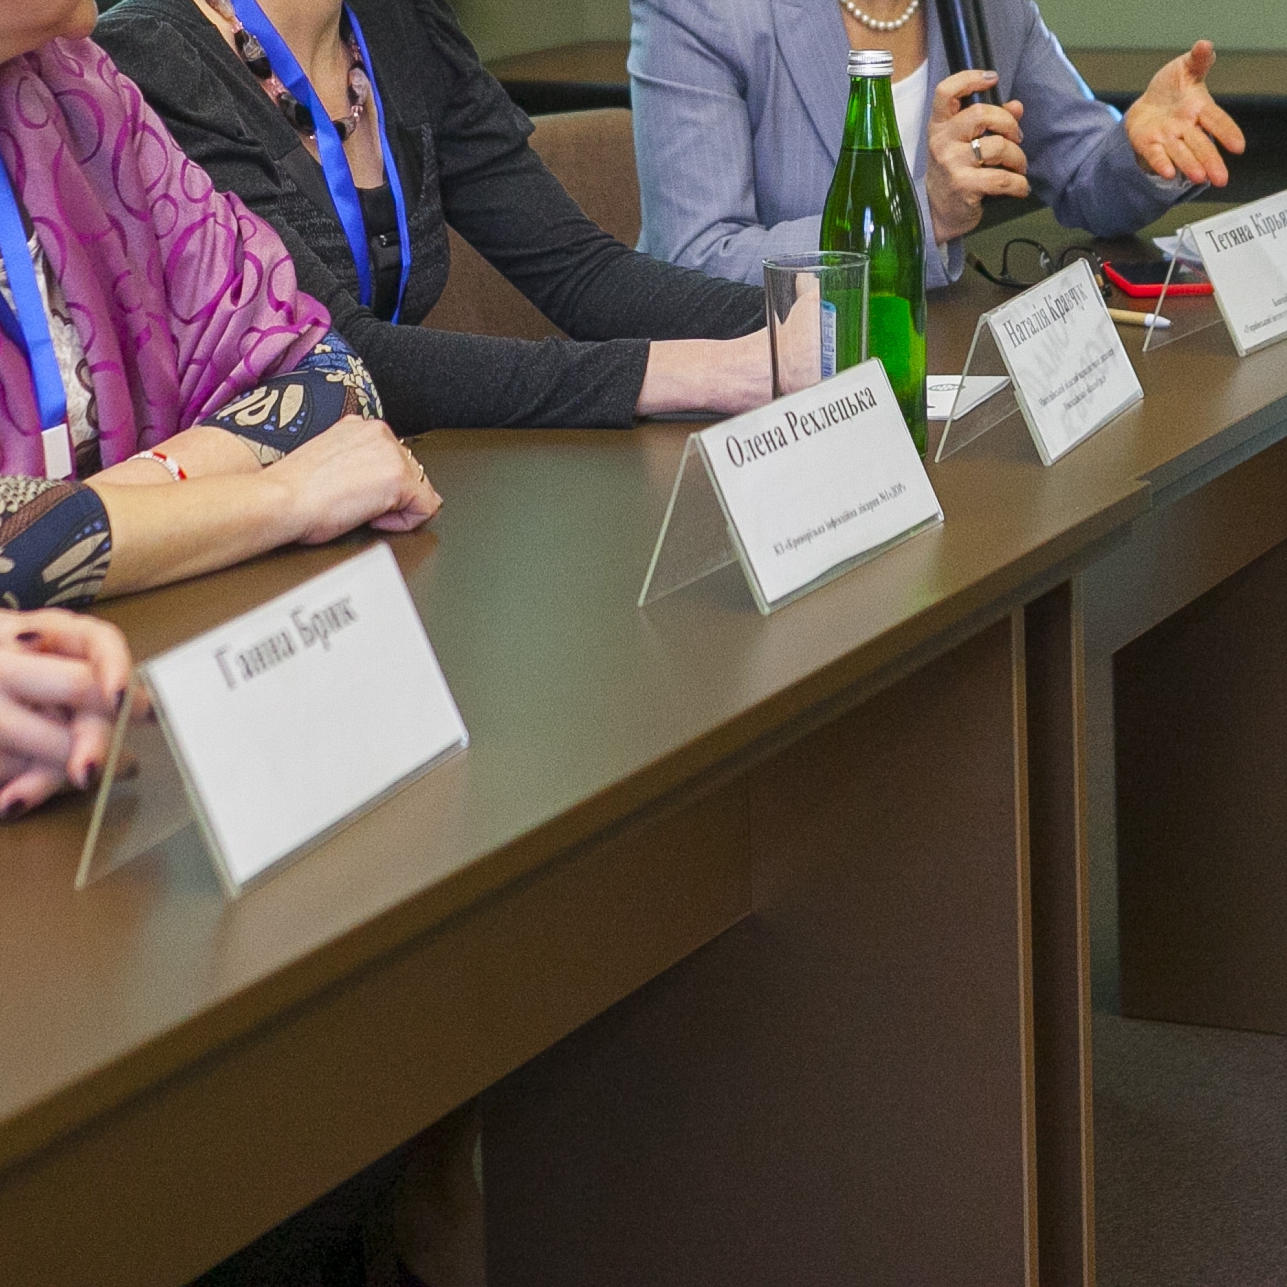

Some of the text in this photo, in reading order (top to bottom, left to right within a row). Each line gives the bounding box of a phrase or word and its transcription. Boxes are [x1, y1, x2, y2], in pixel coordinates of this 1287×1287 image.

[1205, 224, 1255, 253] Тетяна
[1002, 282, 1089, 349] Наталія Кравчук
[725, 386, 878, 468] Олена Рехлецька
[290, 594, 358, 651] Брик
